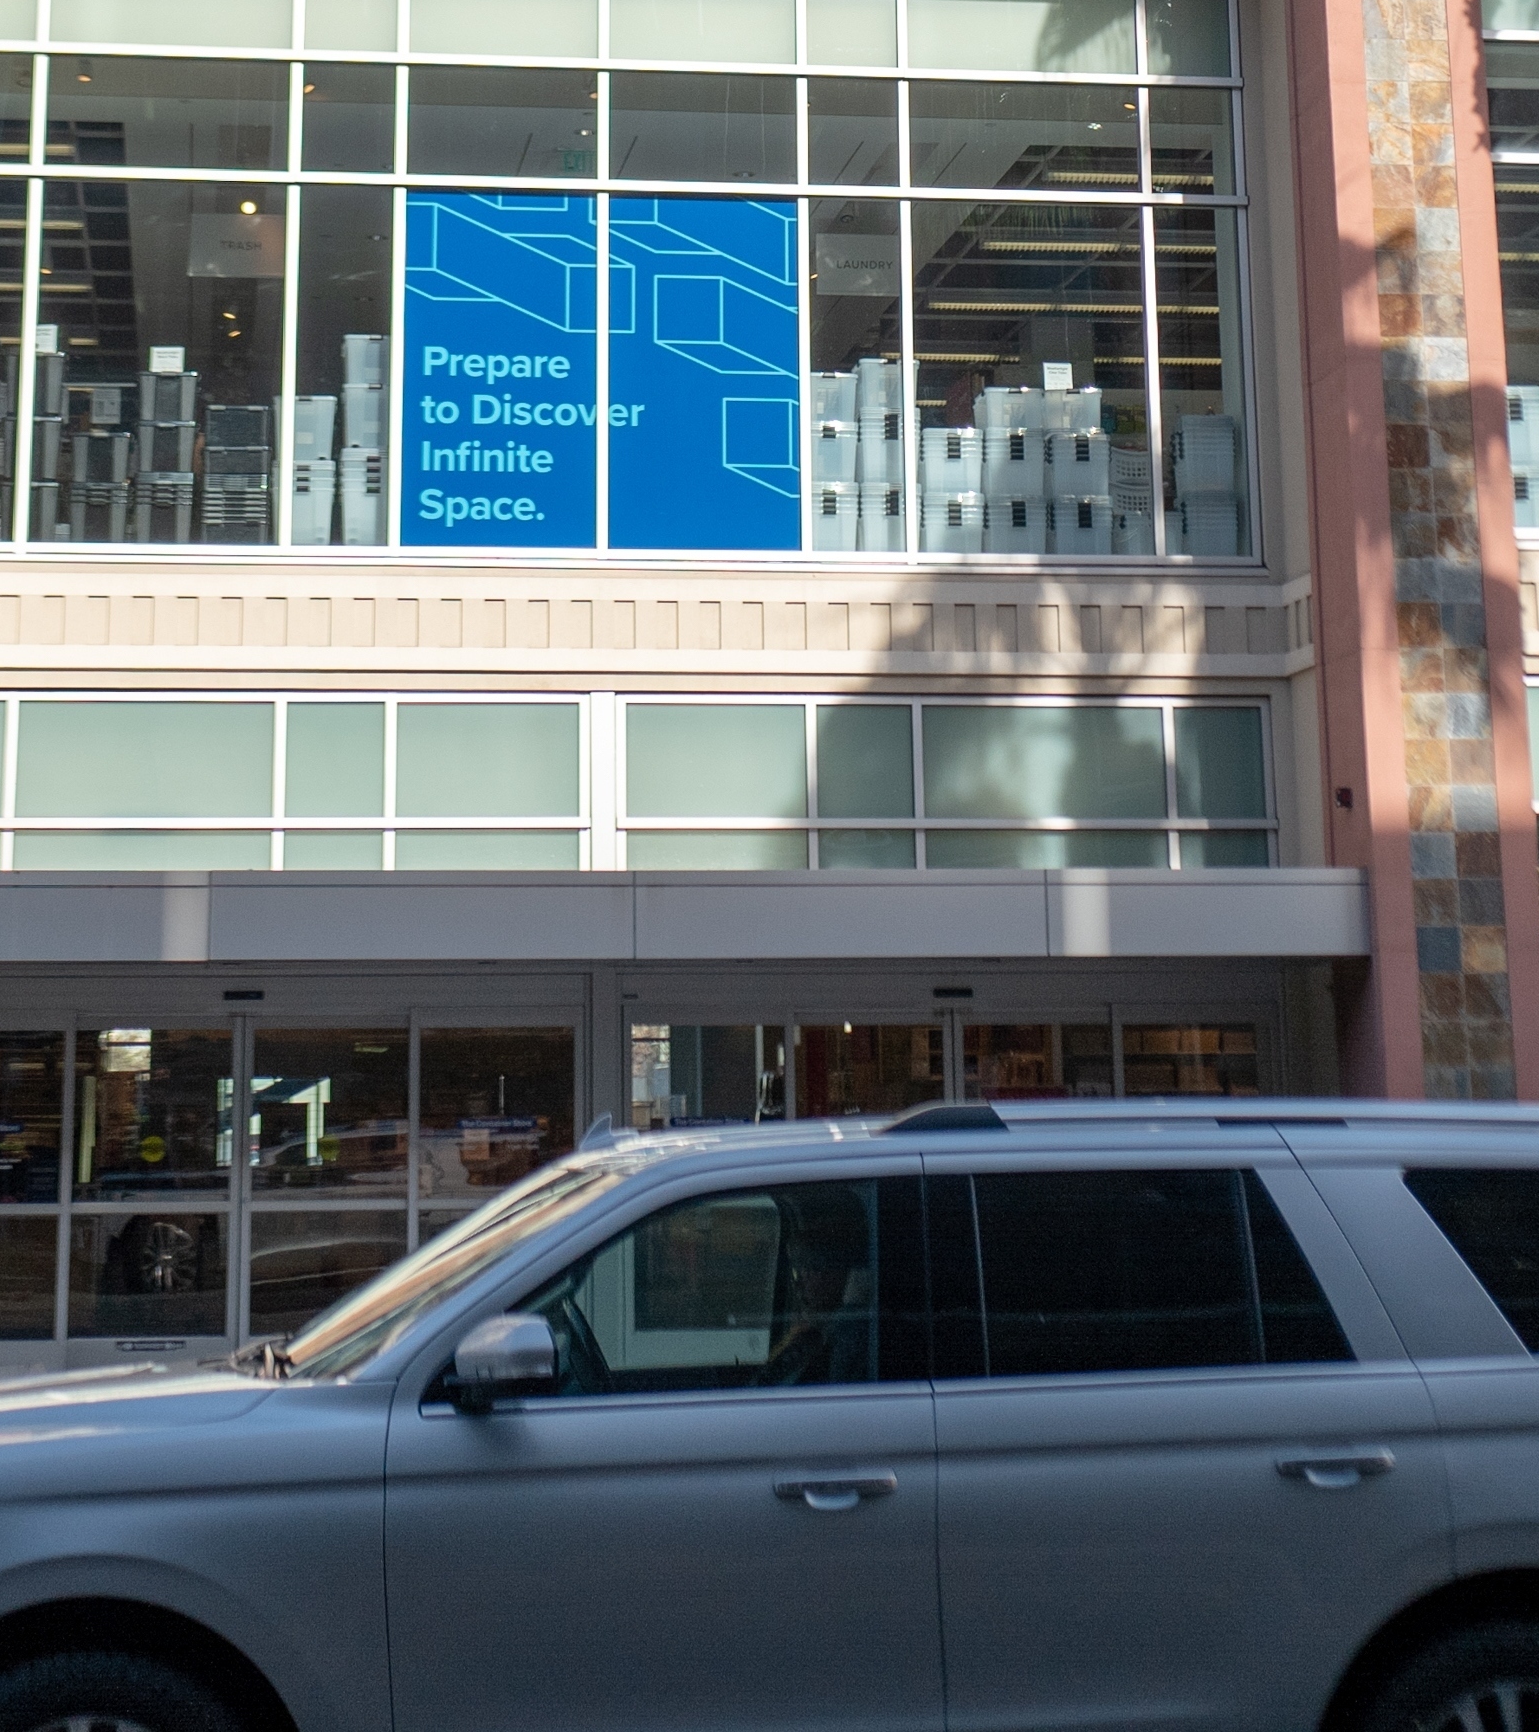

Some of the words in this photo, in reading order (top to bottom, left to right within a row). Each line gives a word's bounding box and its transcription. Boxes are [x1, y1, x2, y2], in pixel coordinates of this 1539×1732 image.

[221, 241, 262, 251] TRASH
[836, 260, 893, 270] LAUNDRY
[422, 346, 571, 384] Prepare
[420, 395, 460, 424] to
[472, 393, 645, 427] Discover
[420, 440, 554, 473] Infinite
[418, 488, 545, 527] Space.
